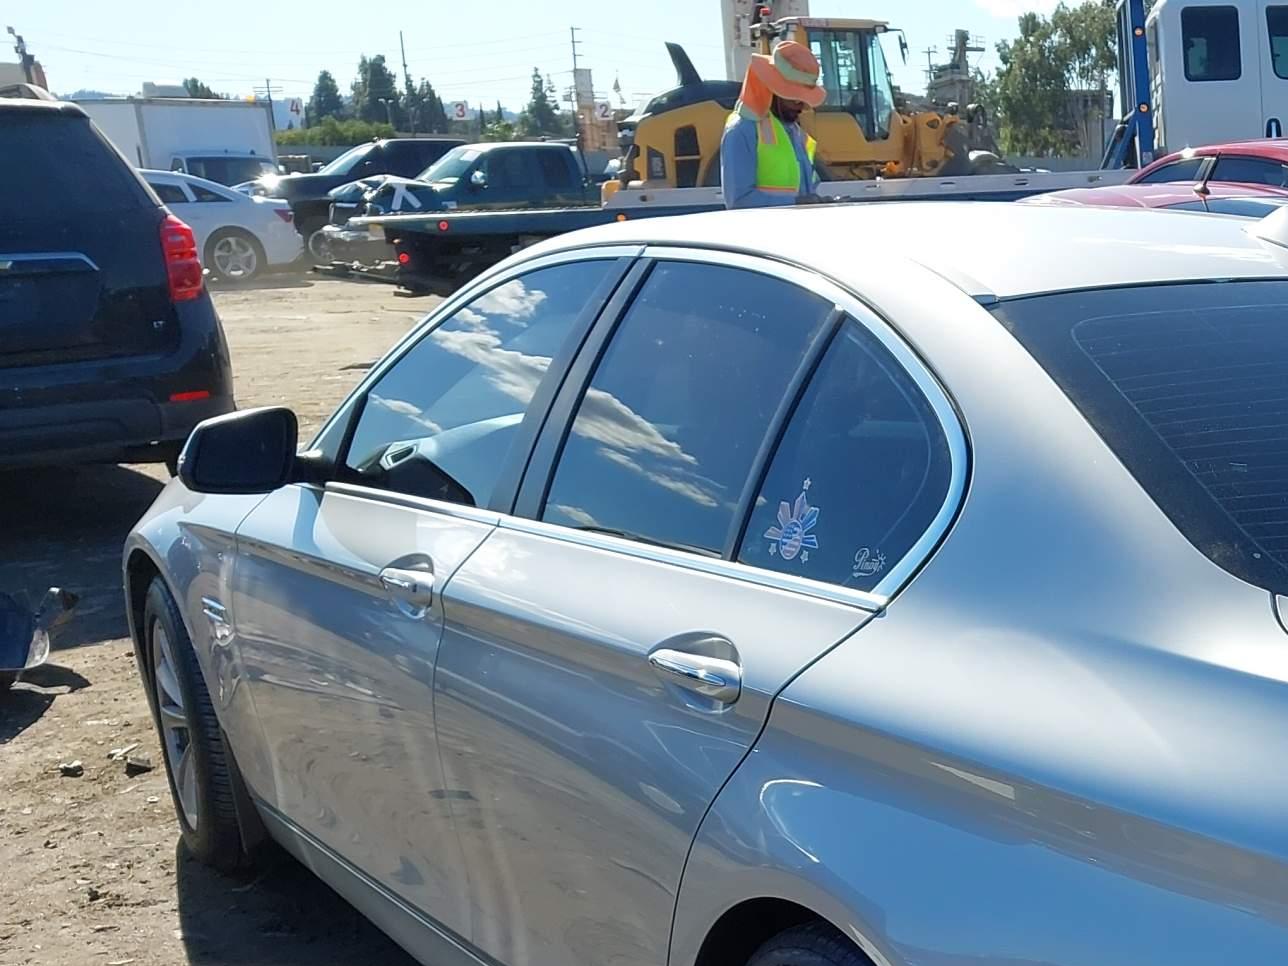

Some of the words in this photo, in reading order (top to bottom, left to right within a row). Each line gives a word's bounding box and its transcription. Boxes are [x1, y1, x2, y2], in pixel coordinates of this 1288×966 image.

[290, 99, 301, 115] 4
[455, 103, 466, 118] 3
[600, 104, 610, 118] 2
